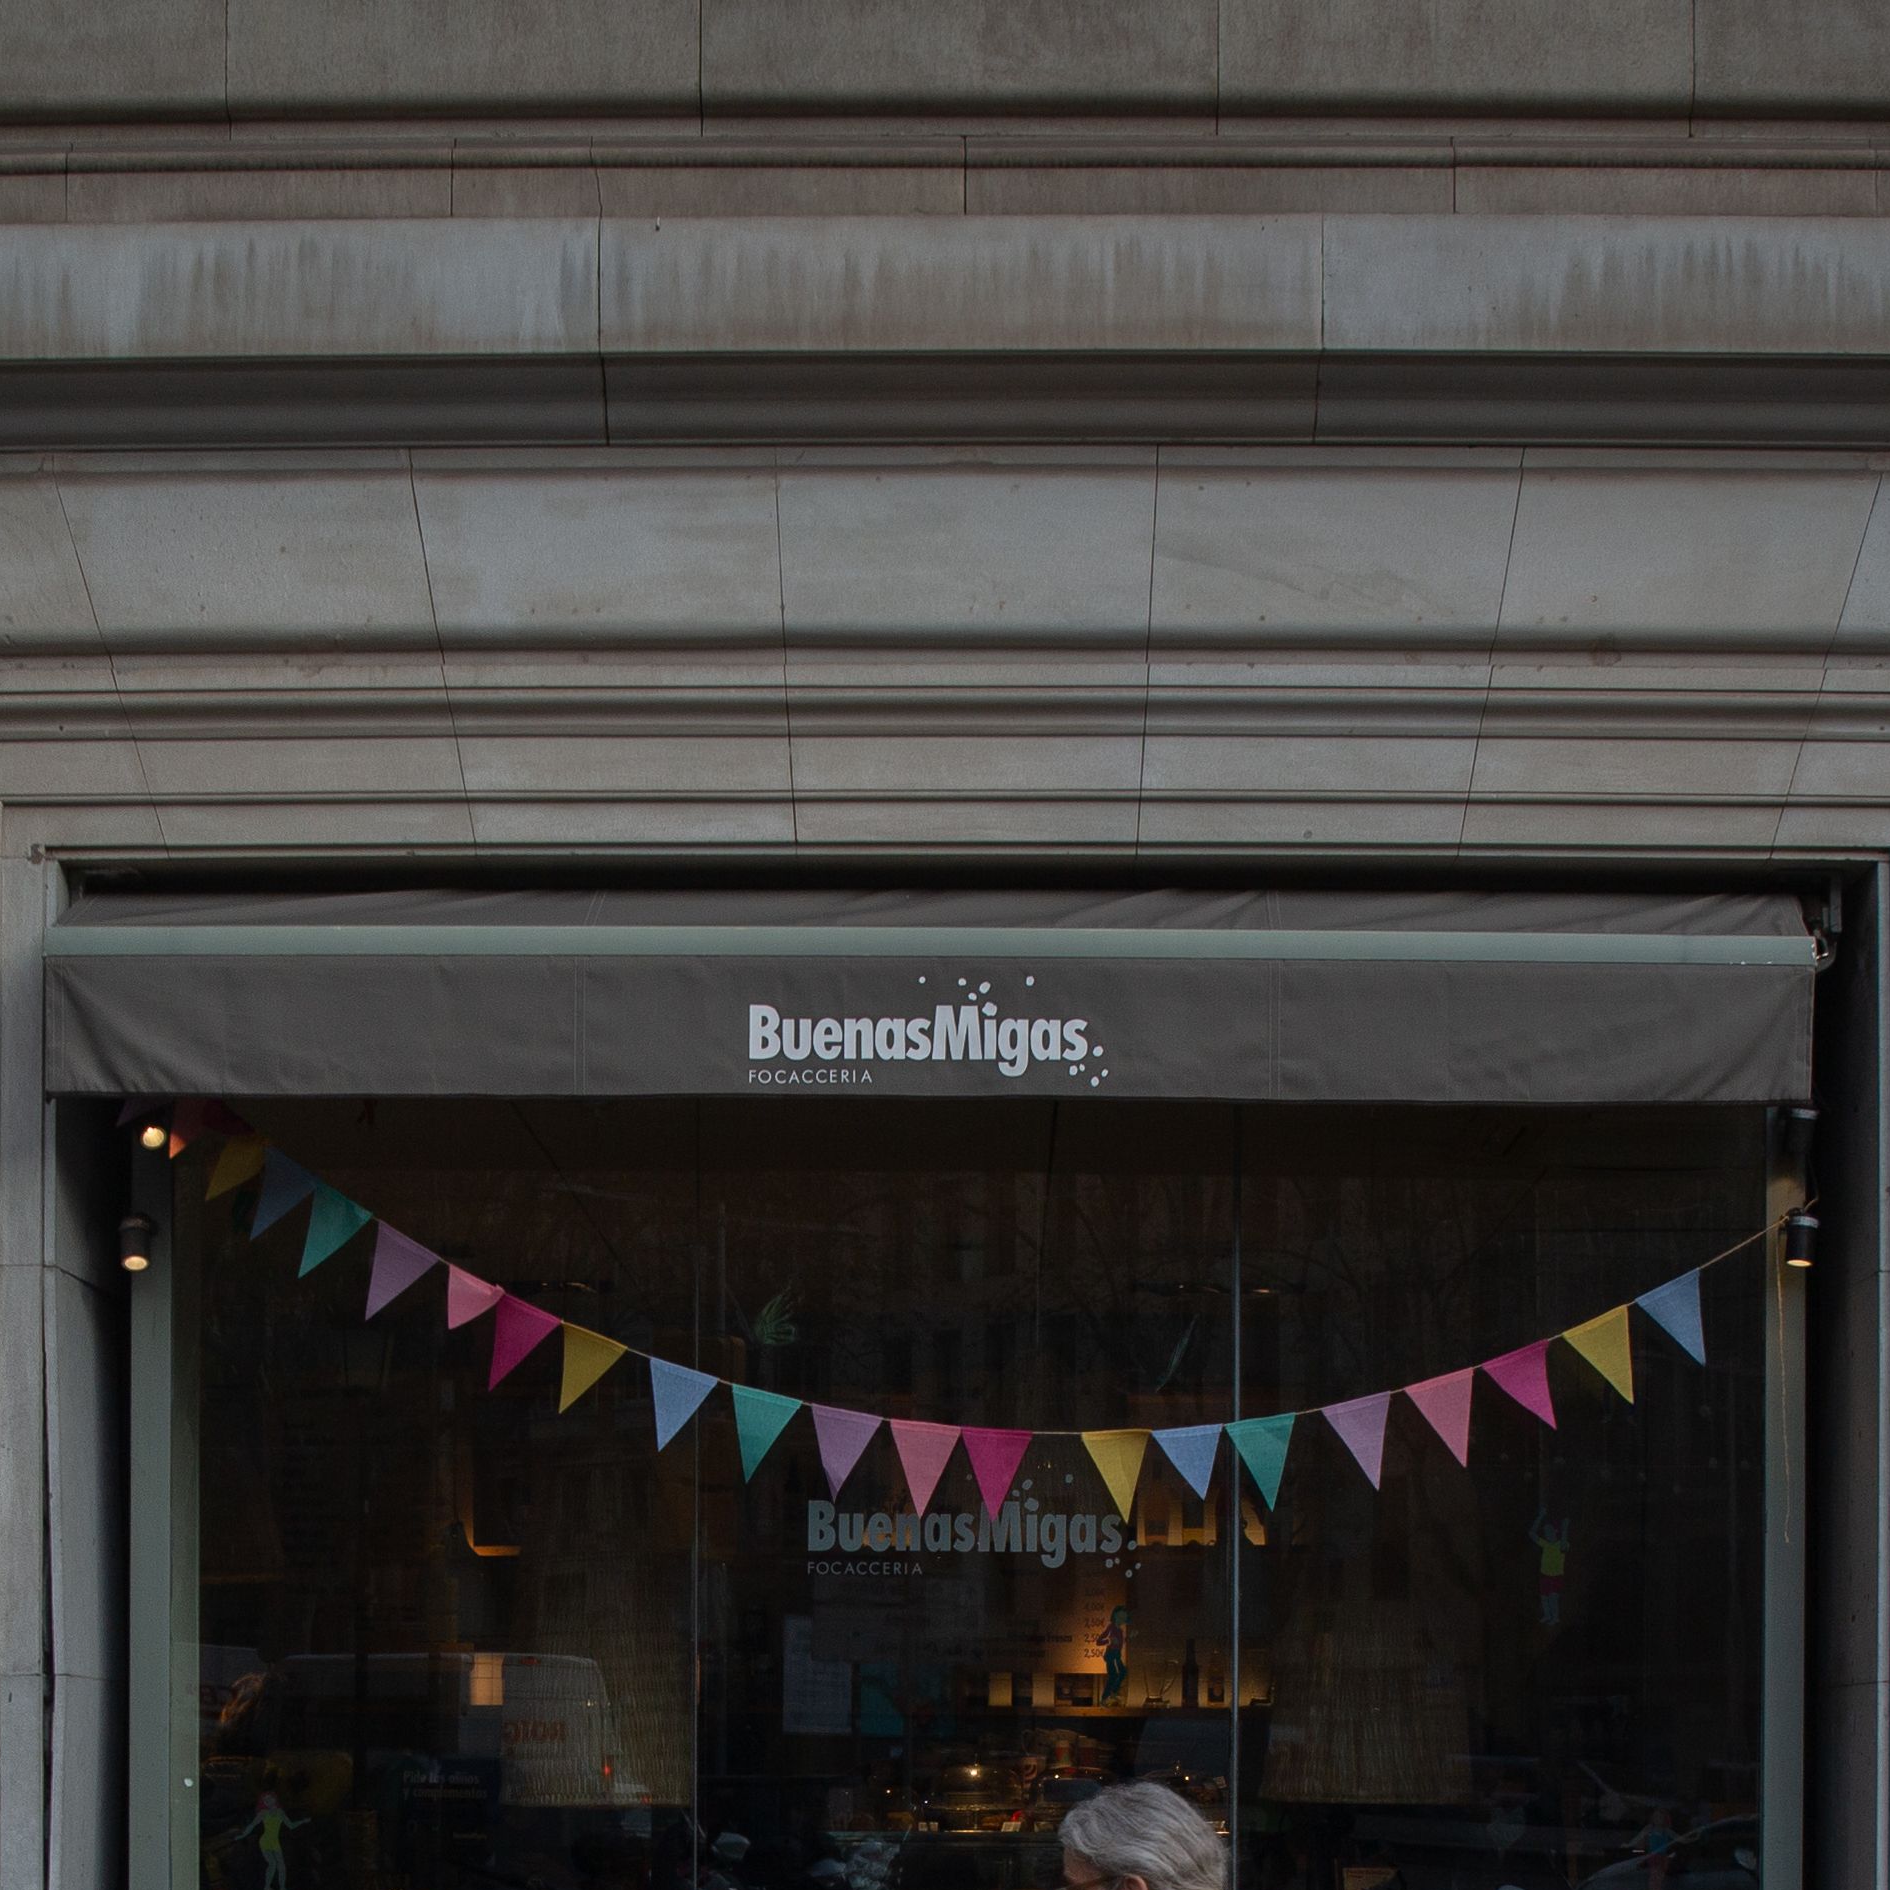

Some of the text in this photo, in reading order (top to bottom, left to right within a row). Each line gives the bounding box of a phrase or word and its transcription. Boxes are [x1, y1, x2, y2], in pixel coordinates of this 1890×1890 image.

[748, 1001, 1089, 1077] BuenasMigas
[748, 1069, 873, 1084] FOCACCERIA
[806, 1498, 1123, 1568] BuenasMigas
[806, 1561, 923, 1576] FOCACCERIA
